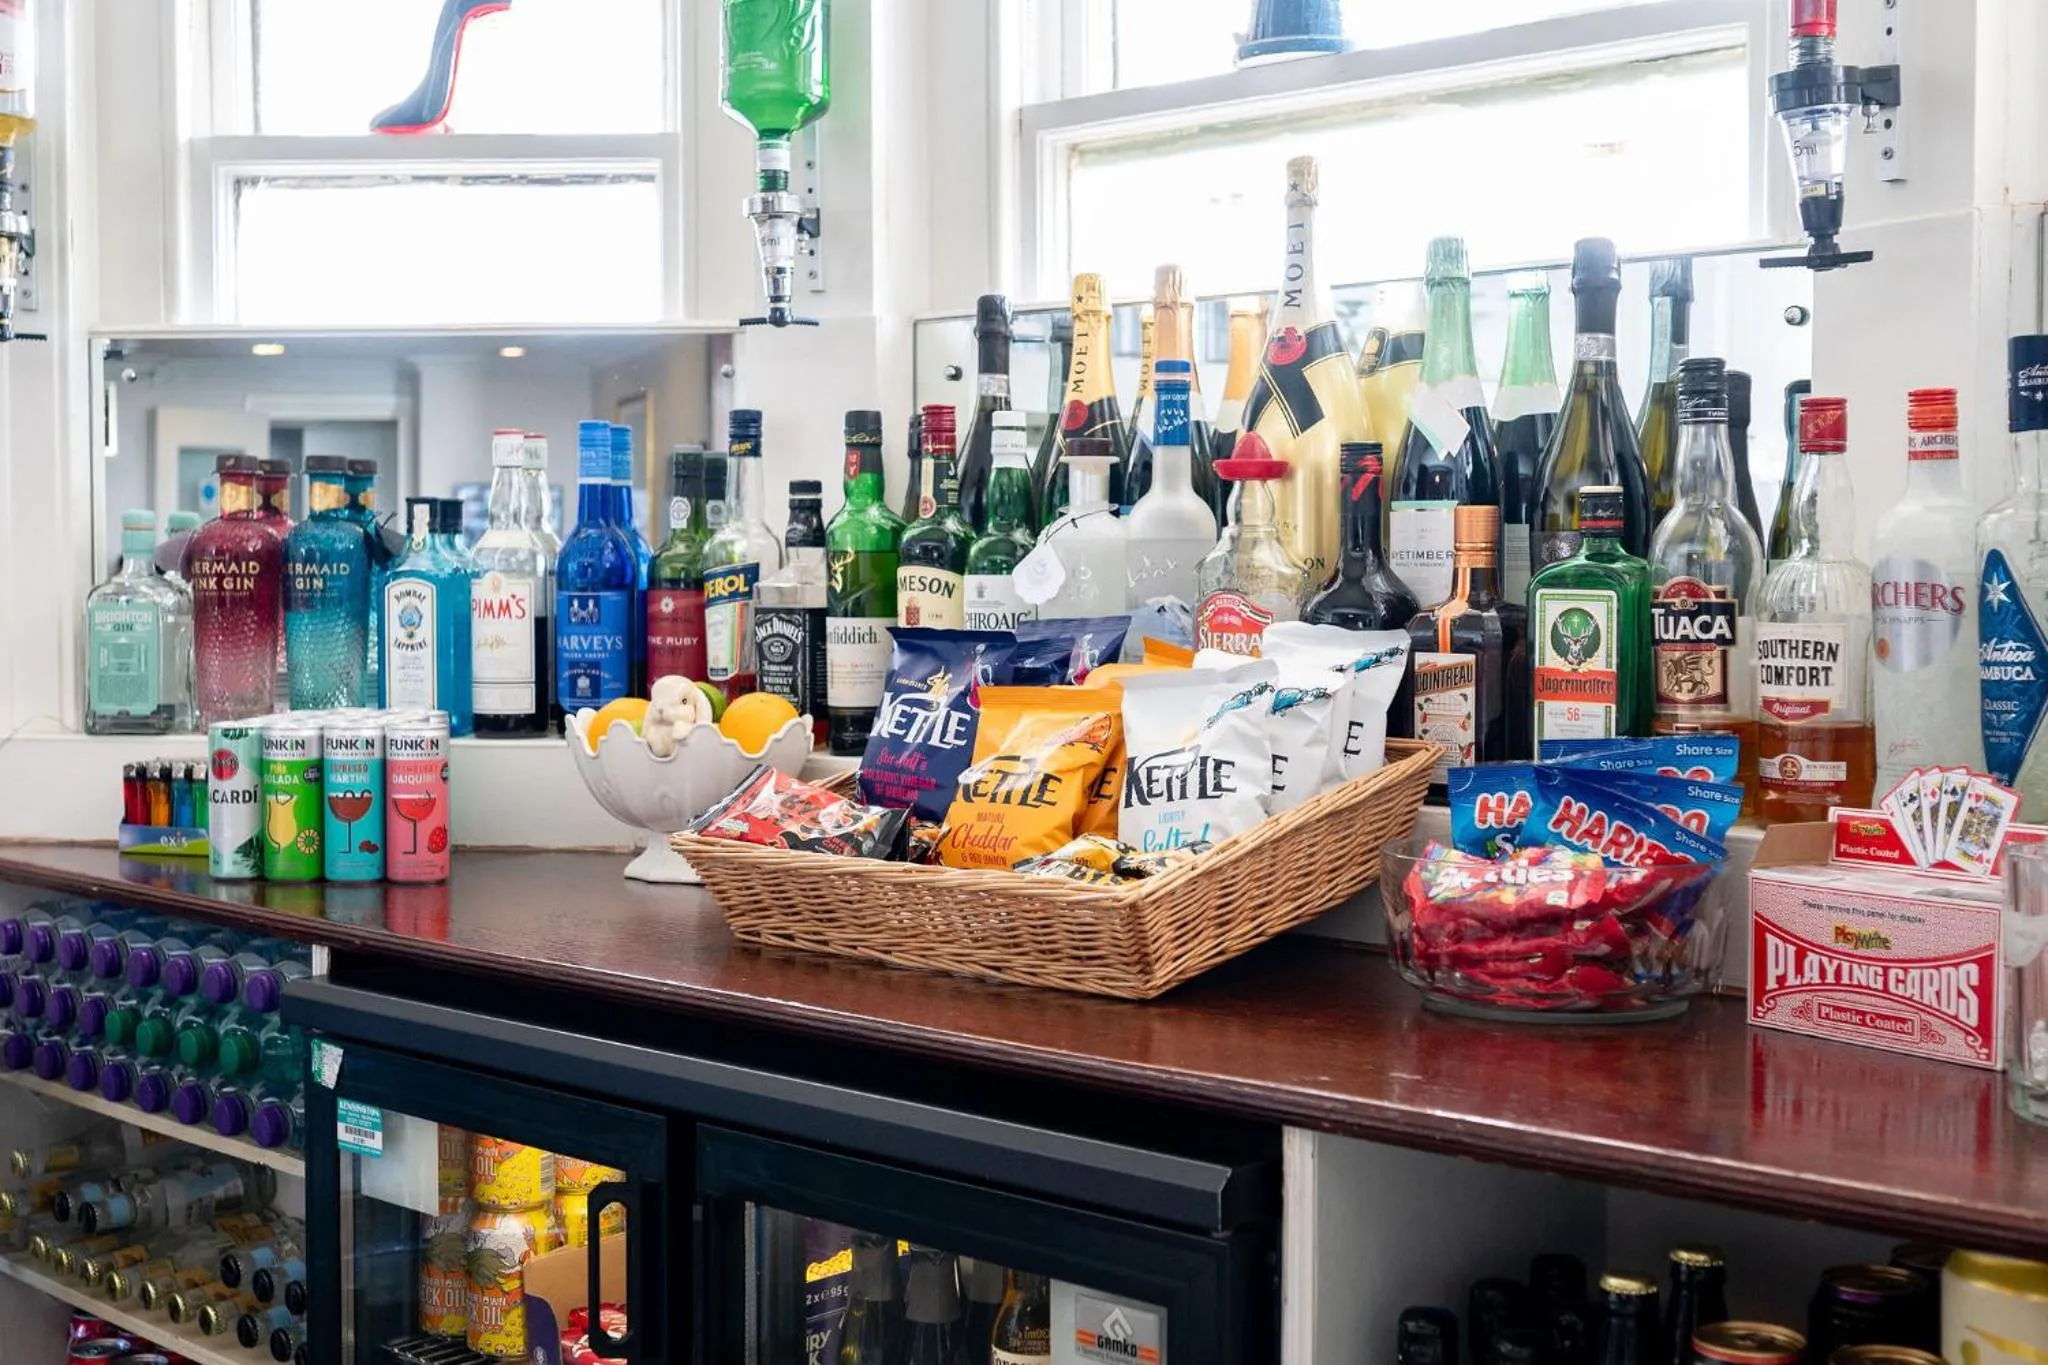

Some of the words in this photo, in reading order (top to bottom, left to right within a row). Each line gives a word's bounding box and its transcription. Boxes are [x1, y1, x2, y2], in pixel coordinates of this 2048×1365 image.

[1793, 139, 1817, 157] 5ml
[193, 561, 260, 575] ERMAID
[286, 562, 350, 576] ERMAID
[222, 576, 255, 590] GIN
[295, 577, 325, 590] GIN
[704, 573, 749, 598] PEROL
[1872, 580, 1967, 616] RCHERS
[1758, 638, 1840, 663] SOUTHERN
[1980, 665, 2037, 681] AMBUCA
[869, 691, 972, 749] KETTLE
[1567, 706, 1581, 722] 56
[1675, 743, 1713, 756] Share
[1599, 758, 1635, 771] Share
[1124, 746, 1238, 809] KETTLE
[211, 784, 259, 804] CARDÍ
[1687, 785, 1722, 801] Share
[1675, 830, 1708, 853] Share
[1840, 843, 1869, 856] Plastic
[1764, 932, 1885, 992] PLAYING
[1886, 962, 1980, 1029] CARDS
[1820, 1005, 1863, 1026] Plastic
[1864, 1010, 1913, 1034] Coated
